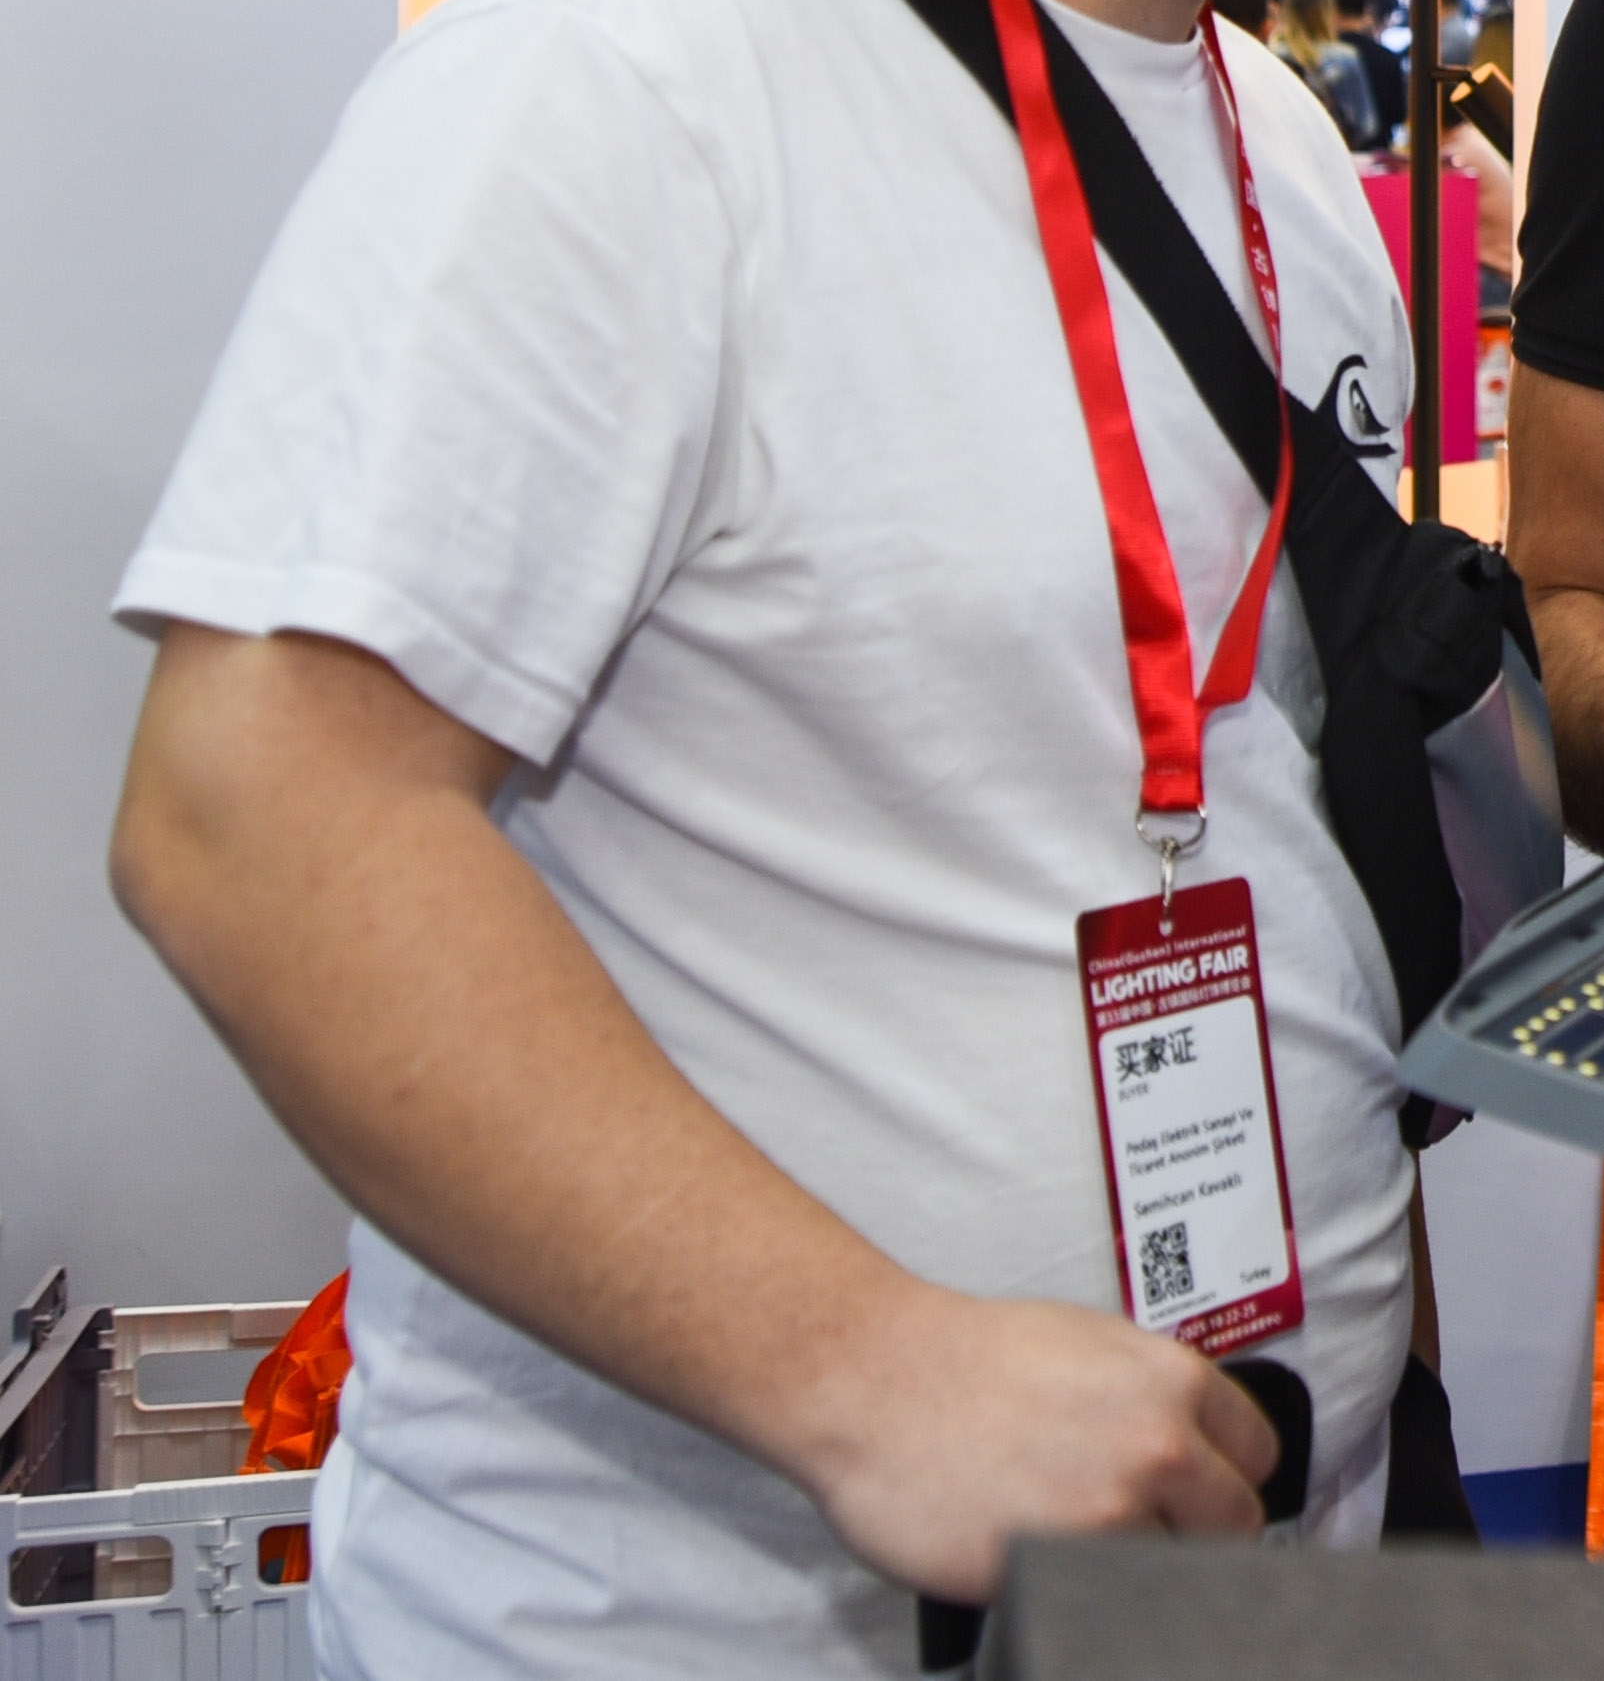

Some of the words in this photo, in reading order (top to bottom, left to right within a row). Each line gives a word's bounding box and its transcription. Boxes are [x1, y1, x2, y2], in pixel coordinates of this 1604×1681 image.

[1090, 957, 1197, 1008] LIGHTING
[1198, 944, 1249, 980] FAIR
[1115, 1026, 1198, 1083] 买家证
